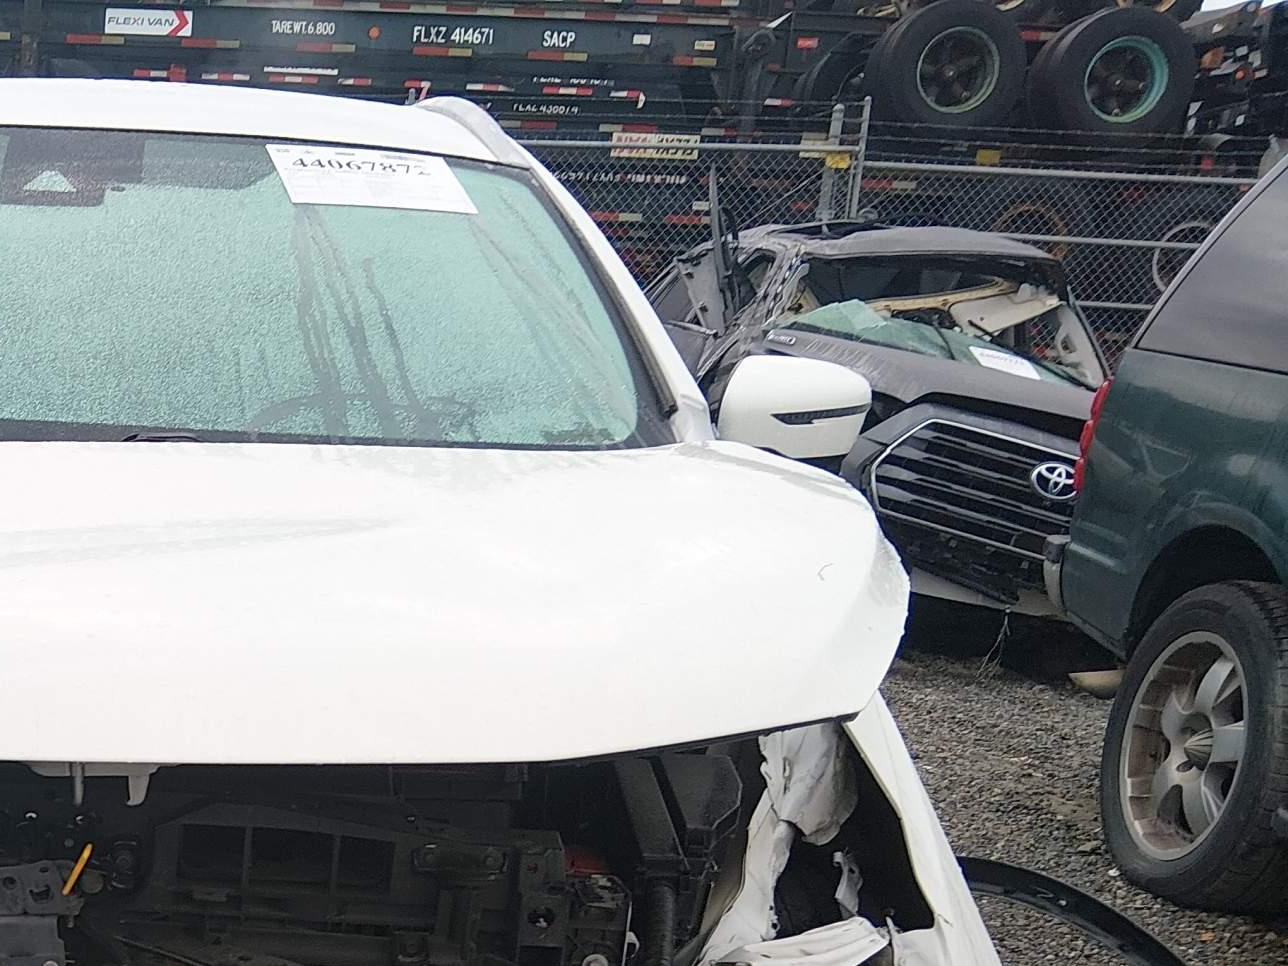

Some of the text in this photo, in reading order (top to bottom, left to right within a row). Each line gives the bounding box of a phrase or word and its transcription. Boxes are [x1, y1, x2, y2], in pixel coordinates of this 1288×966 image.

[412, 25, 494, 45] FLXZ 414671
[542, 30, 576, 48] SACP
